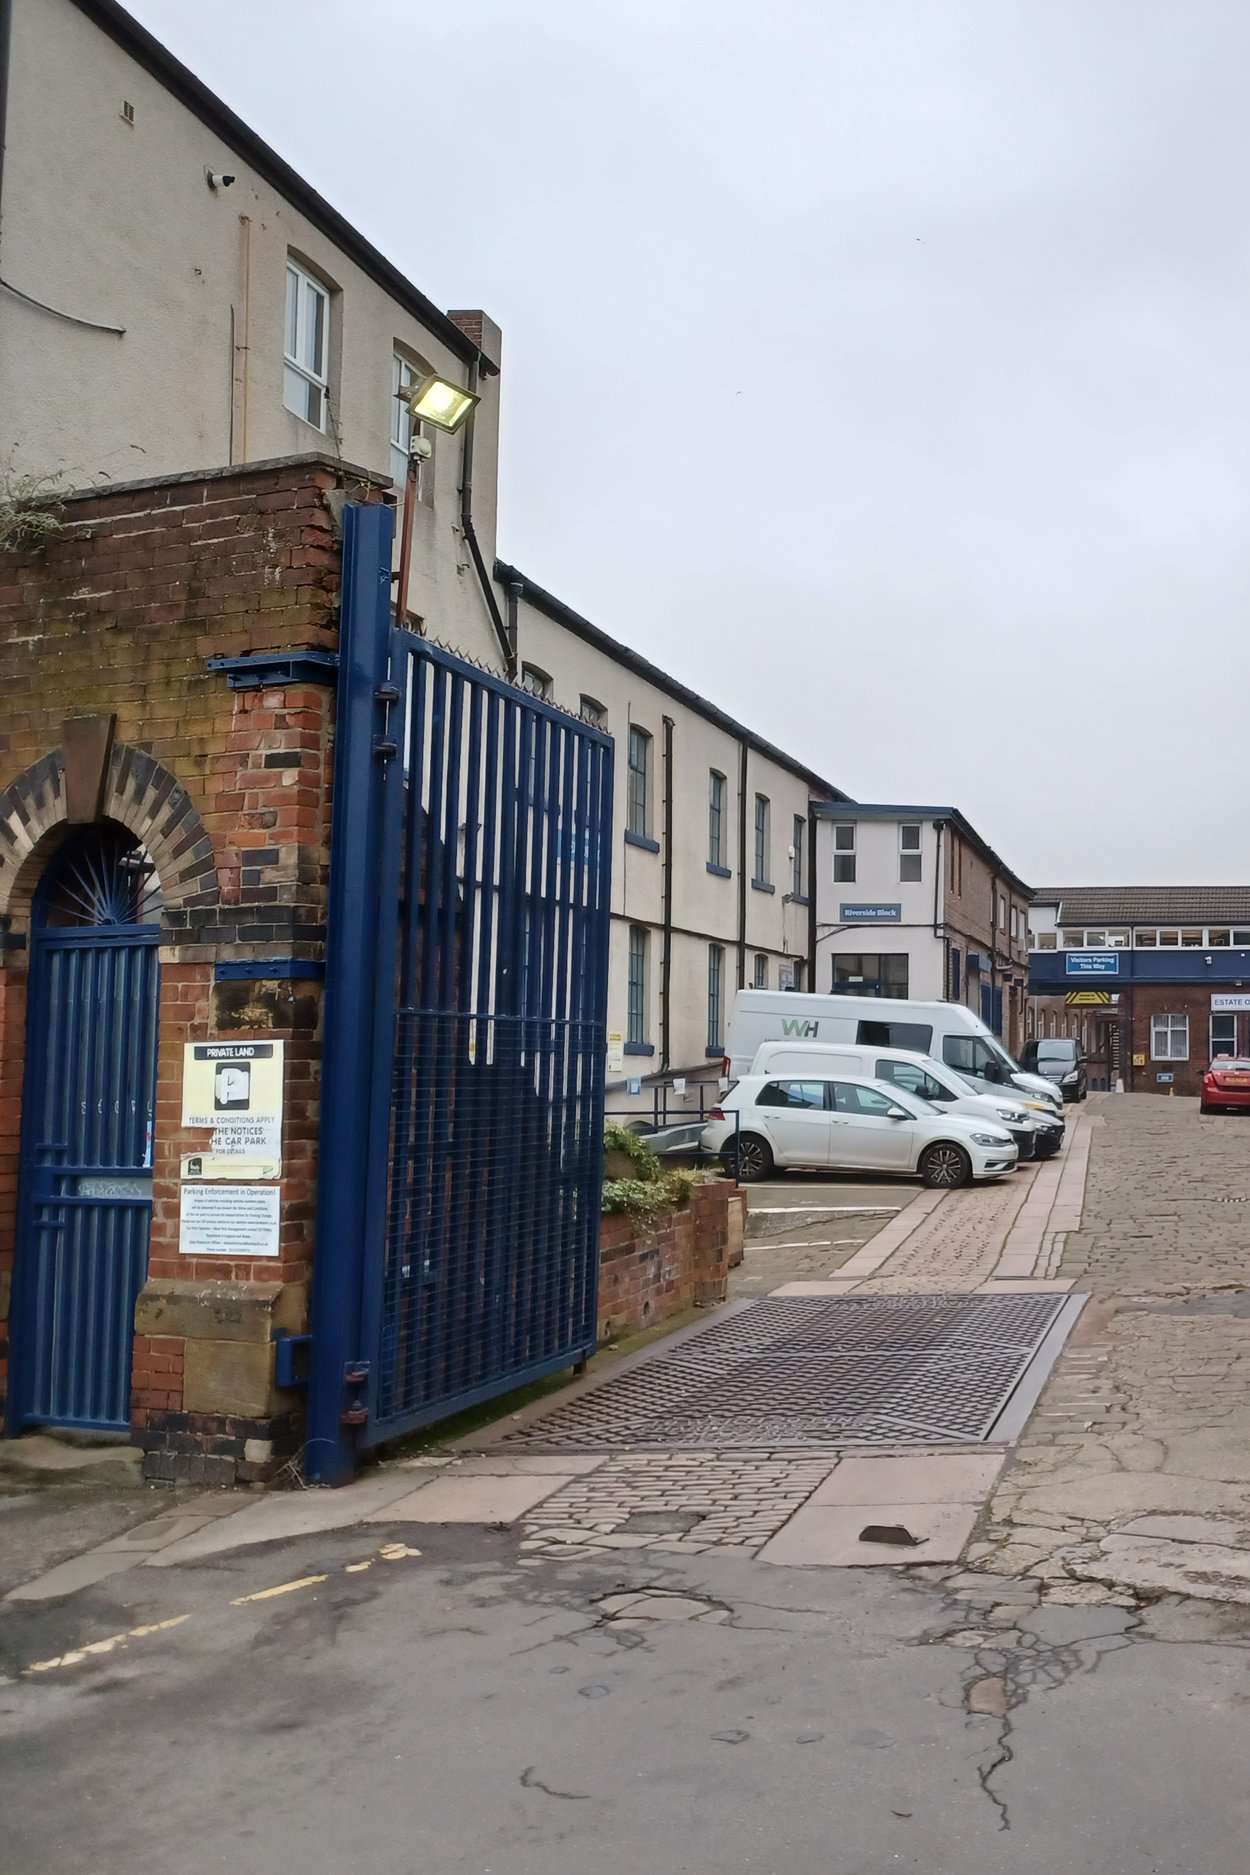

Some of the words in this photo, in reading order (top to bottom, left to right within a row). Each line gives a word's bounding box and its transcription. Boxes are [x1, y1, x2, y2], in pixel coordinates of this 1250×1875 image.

[207, 1048, 233, 1057] PRIVATE
[235, 1047, 254, 1056] LAND
[231, 1127, 263, 1135] NOTICES
[225, 1137, 242, 1145] CAR
[245, 1137, 266, 1145] PARK
[184, 1188, 203, 1196] Parking
[247, 1188, 275, 1196] Operation!
